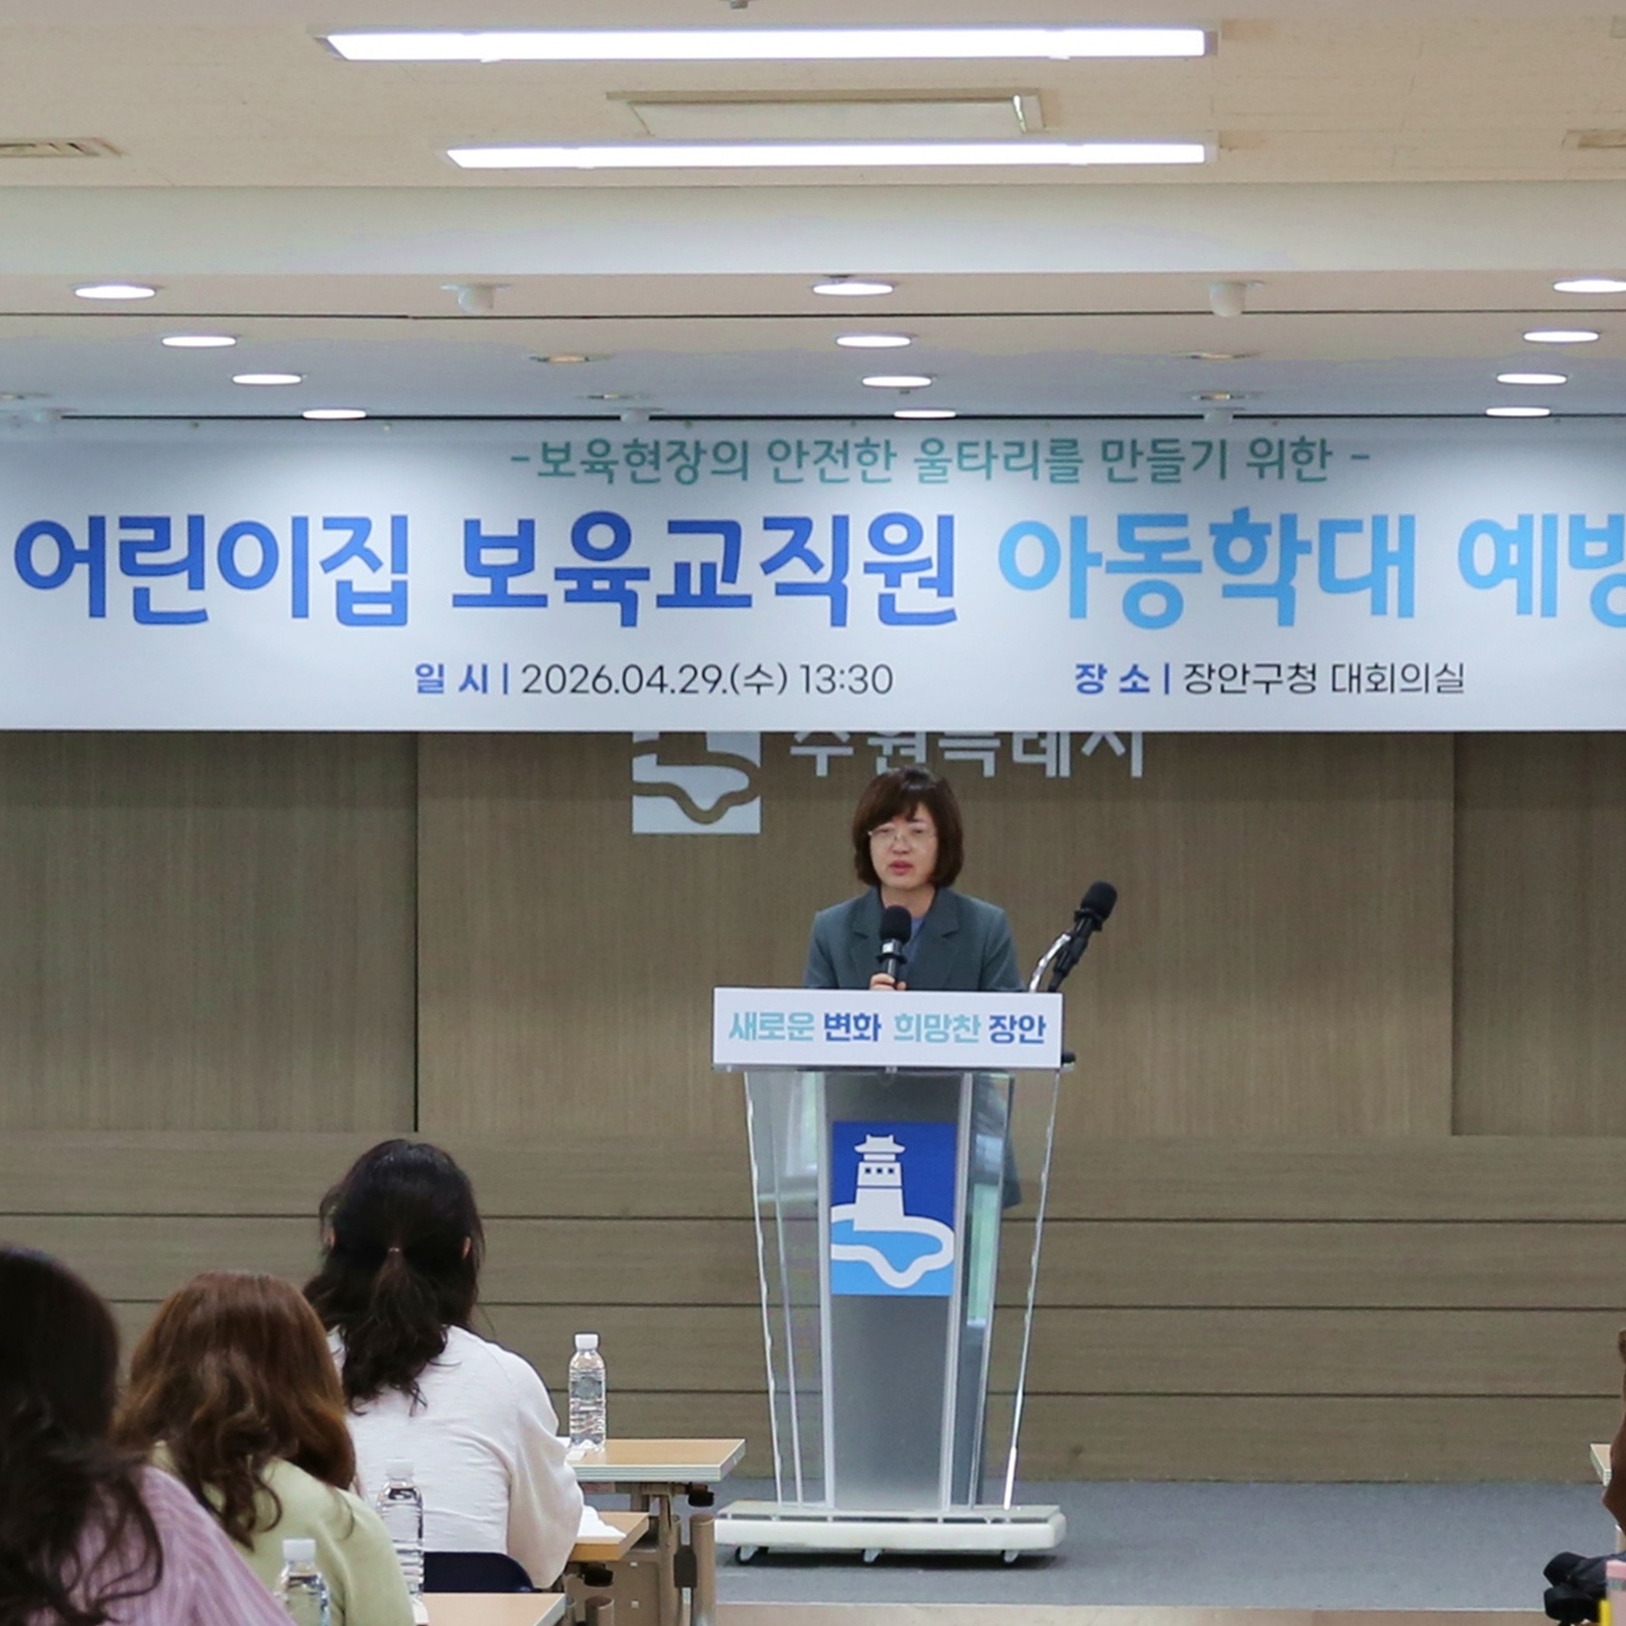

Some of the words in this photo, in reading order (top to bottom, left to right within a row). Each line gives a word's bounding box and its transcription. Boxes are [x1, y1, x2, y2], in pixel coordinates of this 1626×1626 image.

[767, 437, 898, 485] 안전한
[912, 437, 1085, 485] 울타리를
[1100, 437, 1228, 485] 만들기
[1245, 435, 1334, 484] 위한
[13, 512, 409, 627] 어린이집
[452, 508, 957, 629] 보육교직원
[999, 506, 1416, 630] 아동학대
[521, 662, 788, 696] 2026.04.29.(수)
[799, 663, 894, 695] 13:30
[1184, 662, 1317, 695] 장안구청
[1331, 662, 1464, 695] 대회의실
[728, 1011, 815, 1042] 새로운
[823, 1012, 882, 1042] 변화
[893, 1012, 982, 1044] 희망찬
[988, 1014, 1047, 1045] 장안
